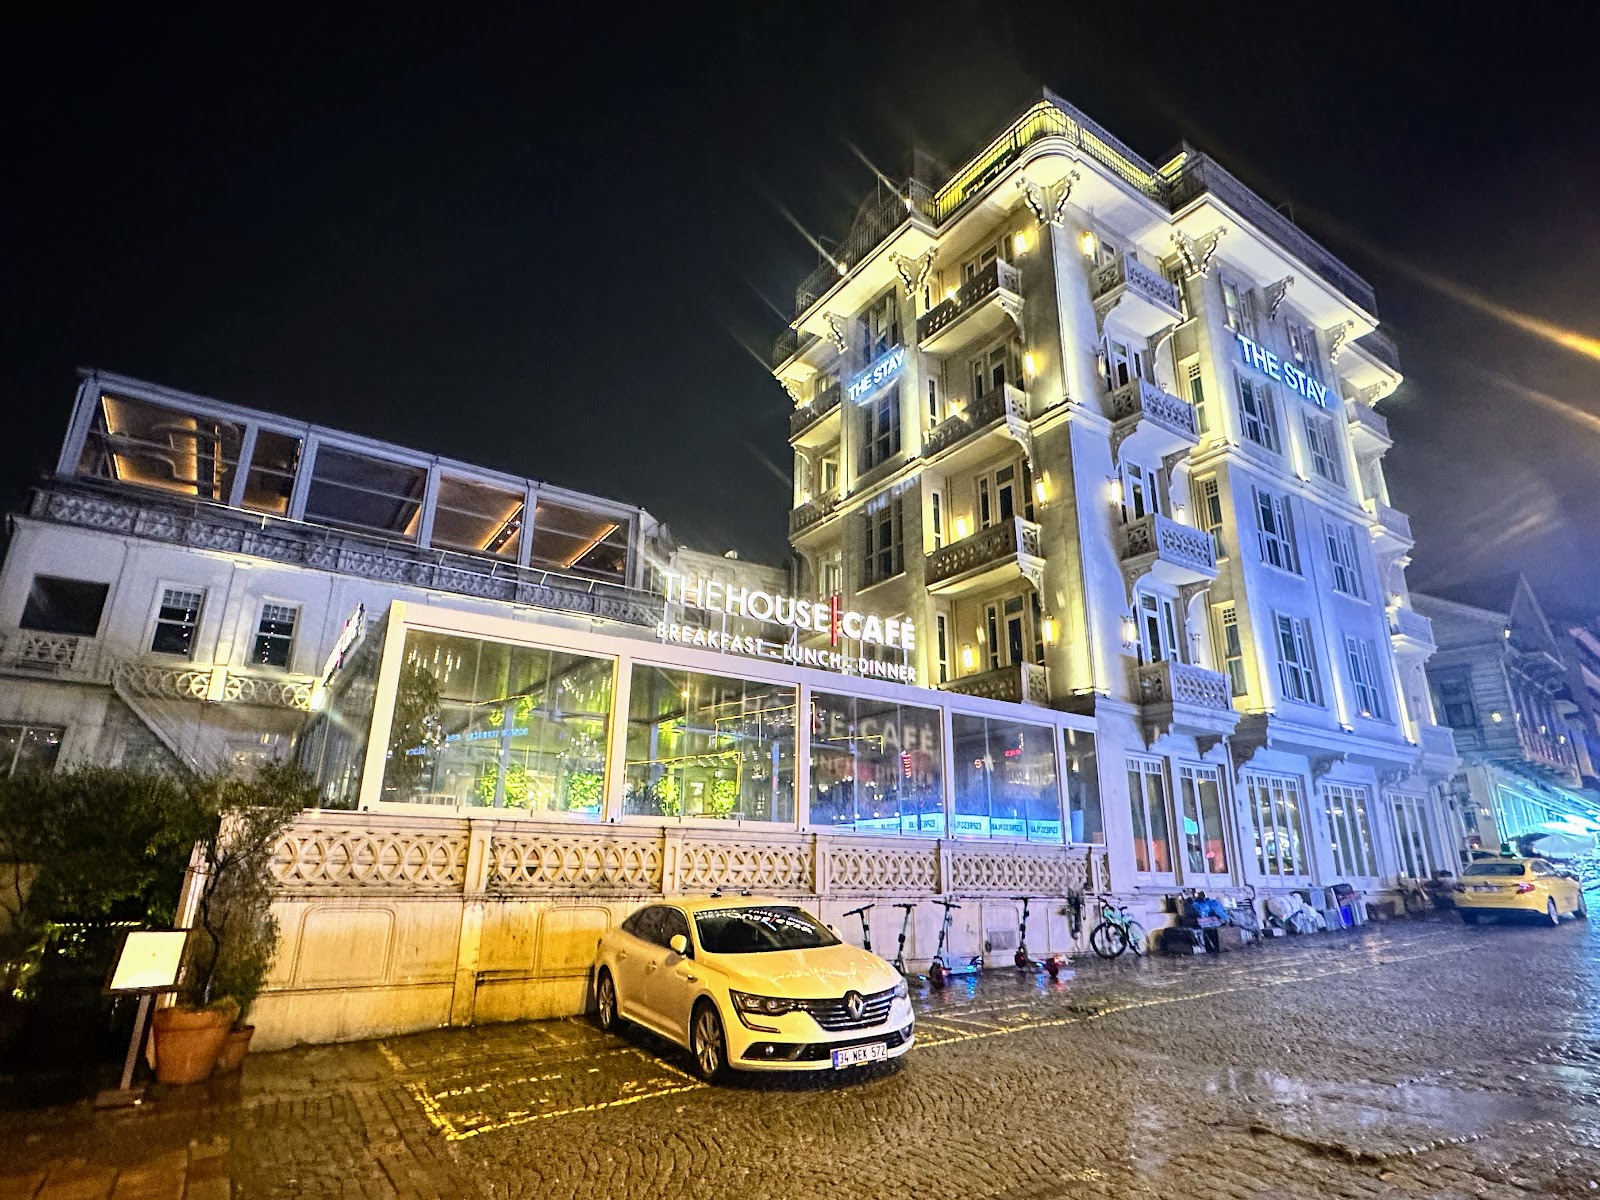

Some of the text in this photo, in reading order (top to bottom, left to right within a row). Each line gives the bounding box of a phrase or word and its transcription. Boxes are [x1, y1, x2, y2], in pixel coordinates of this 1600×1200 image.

[847, 348, 905, 401] THE STAY
[1237, 332, 1327, 408] THE STAY
[656, 621, 916, 682] BREAKFAST LUNCH DINNER
[842, 611, 915, 650] CAFÉ
[839, 1053, 849, 1064] 34
[871, 1045, 886, 1058] 572
